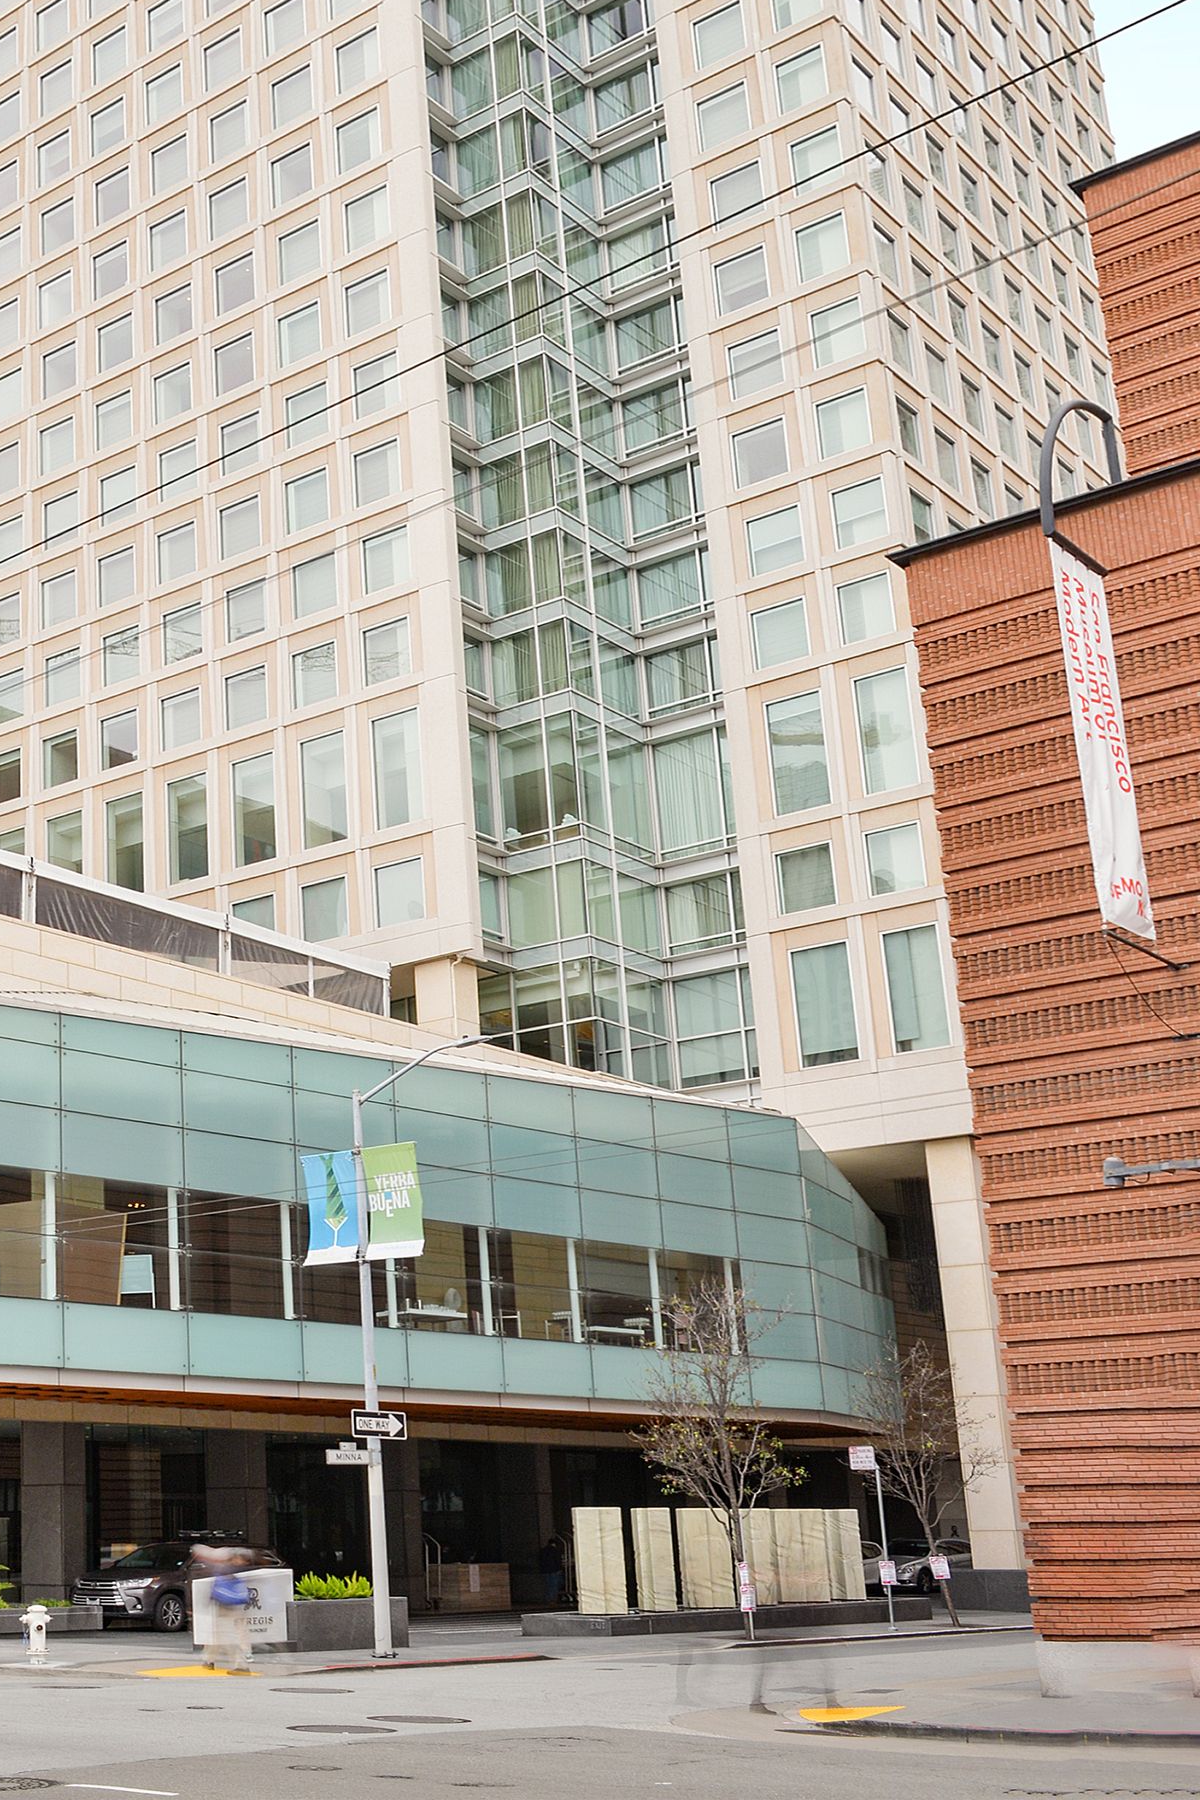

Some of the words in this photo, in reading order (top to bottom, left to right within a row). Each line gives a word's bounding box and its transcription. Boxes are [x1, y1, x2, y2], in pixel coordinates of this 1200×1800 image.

[1060, 568, 1086, 684] Modern
[1097, 653, 1132, 794] Francisco
[374, 1171, 417, 1193] YERBA
[368, 1191, 412, 1218] BUENA
[358, 1418, 373, 1429] ONE
[375, 1419, 390, 1430] WAY
[335, 1453, 363, 1462] MINNA
[246, 1616, 274, 1625] REGIS
